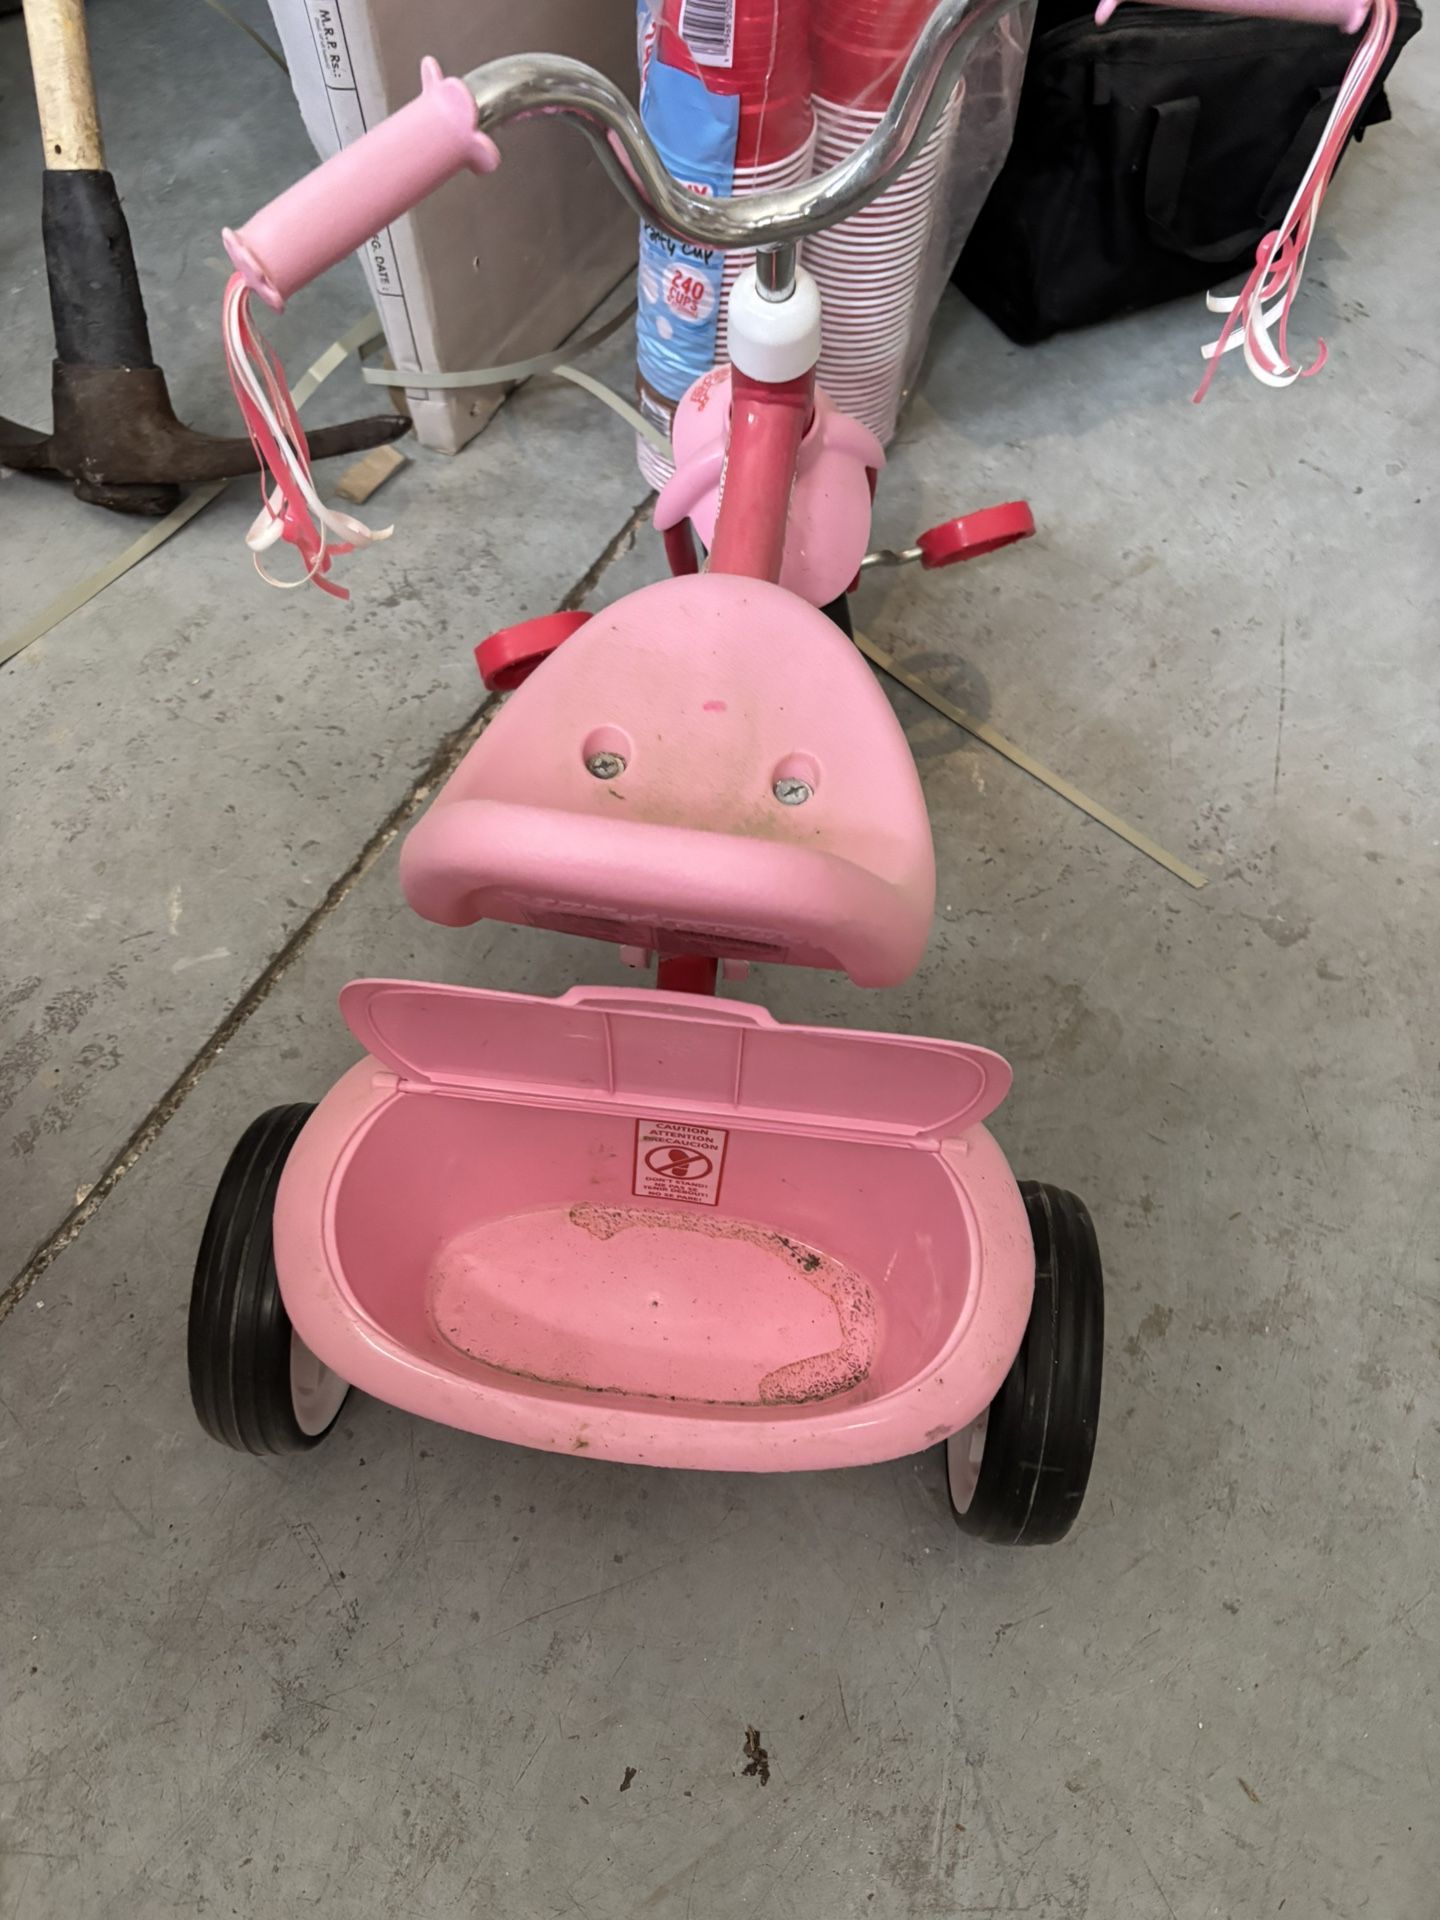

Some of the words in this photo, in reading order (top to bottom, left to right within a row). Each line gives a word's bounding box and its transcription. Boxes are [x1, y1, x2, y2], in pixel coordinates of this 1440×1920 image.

[671, 270, 704, 300] 240
[668, 287, 698, 311] CUPS
[649, 1129, 714, 1143] ATTENTION
[656, 1123, 709, 1135] CAUTION
